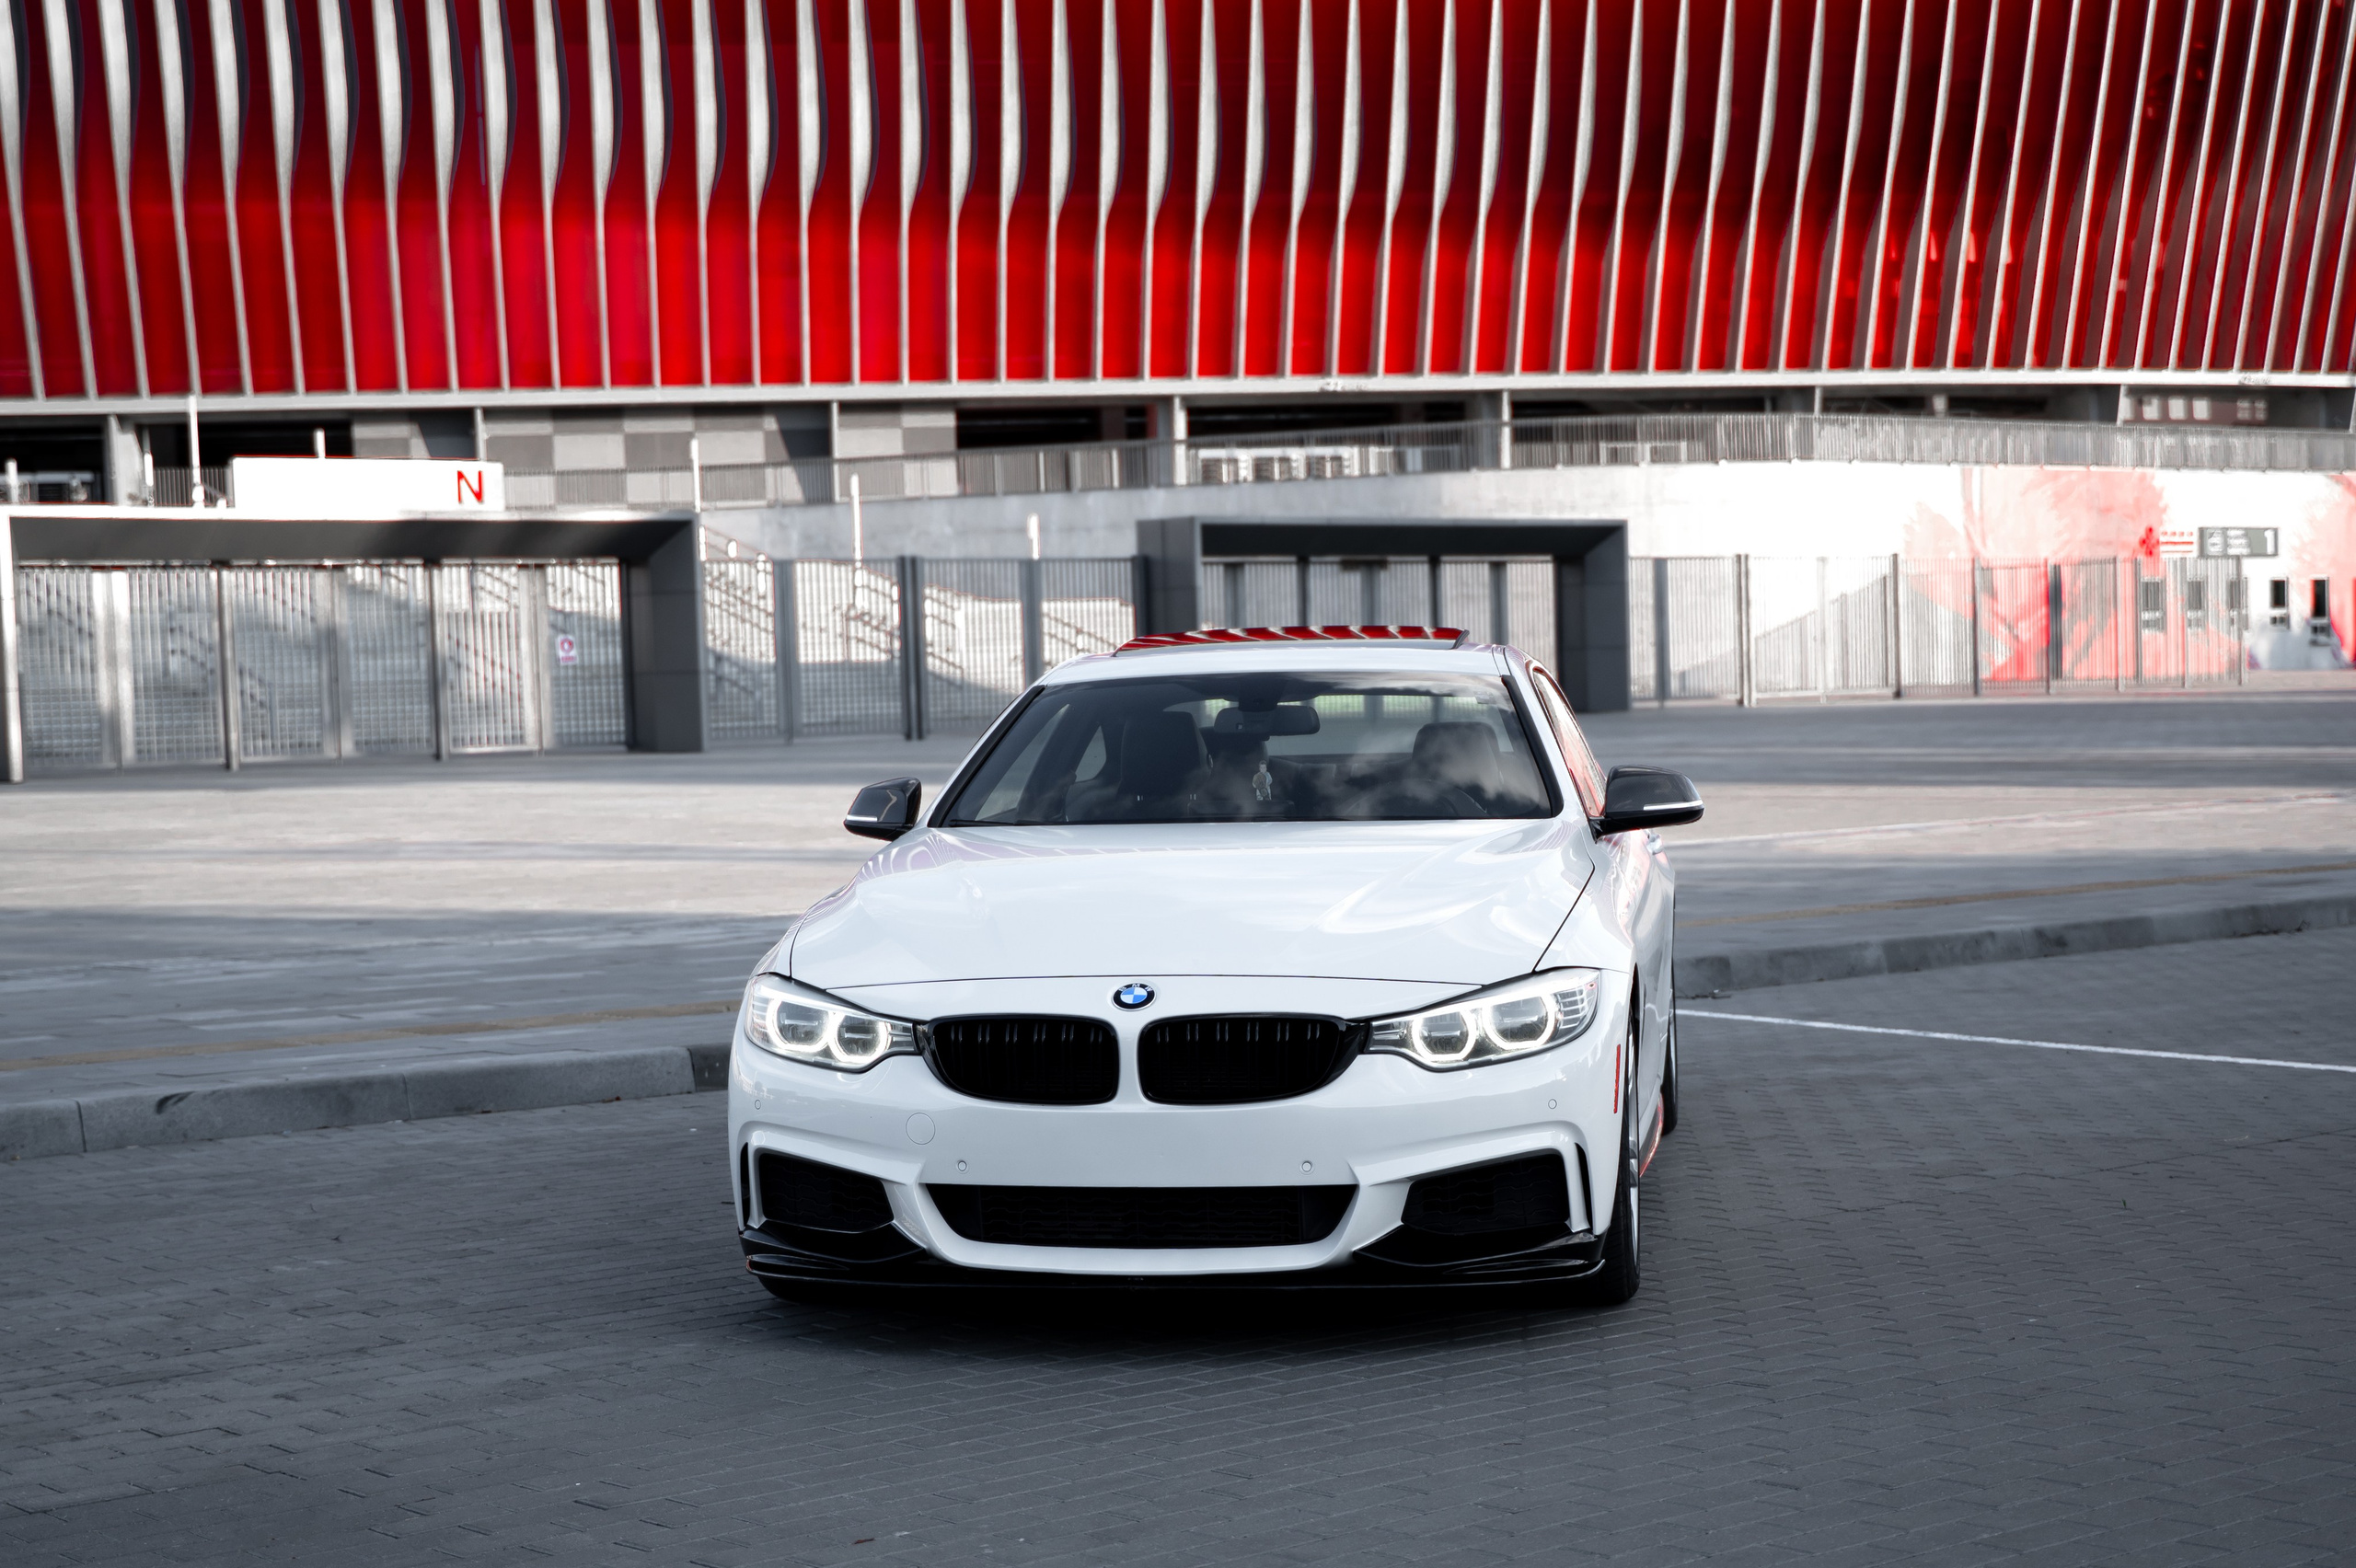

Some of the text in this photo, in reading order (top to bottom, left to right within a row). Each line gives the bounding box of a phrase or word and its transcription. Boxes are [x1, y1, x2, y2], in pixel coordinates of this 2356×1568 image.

[456, 469, 484, 503] N
[2264, 528, 2274, 555] 1
[1117, 982, 1153, 992] BMW
